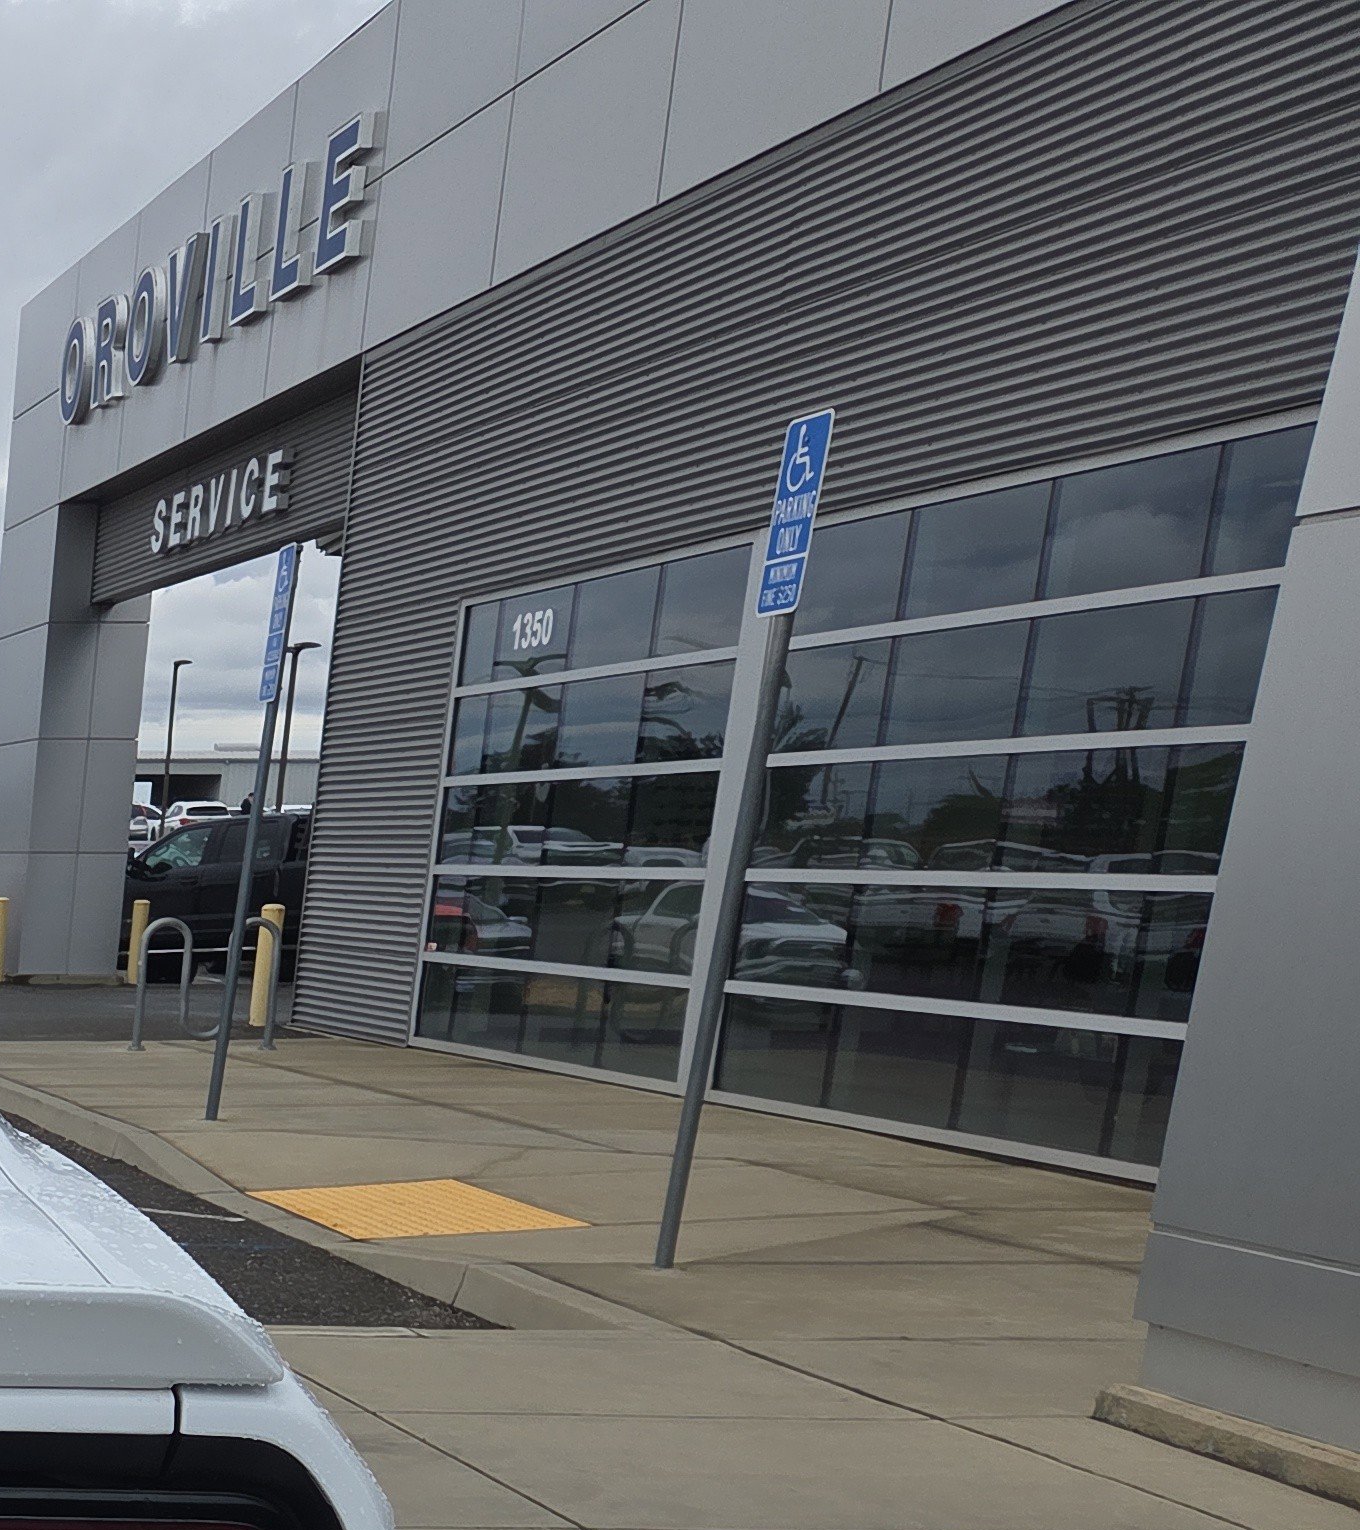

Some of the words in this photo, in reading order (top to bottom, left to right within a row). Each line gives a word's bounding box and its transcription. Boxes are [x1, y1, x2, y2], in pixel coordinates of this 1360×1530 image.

[59, 112, 375, 425] OROVILLE
[150, 449, 288, 554] SERVICE
[772, 490, 817, 526] PARKING
[776, 524, 803, 555] ONLY
[512, 608, 553, 650] 1350
